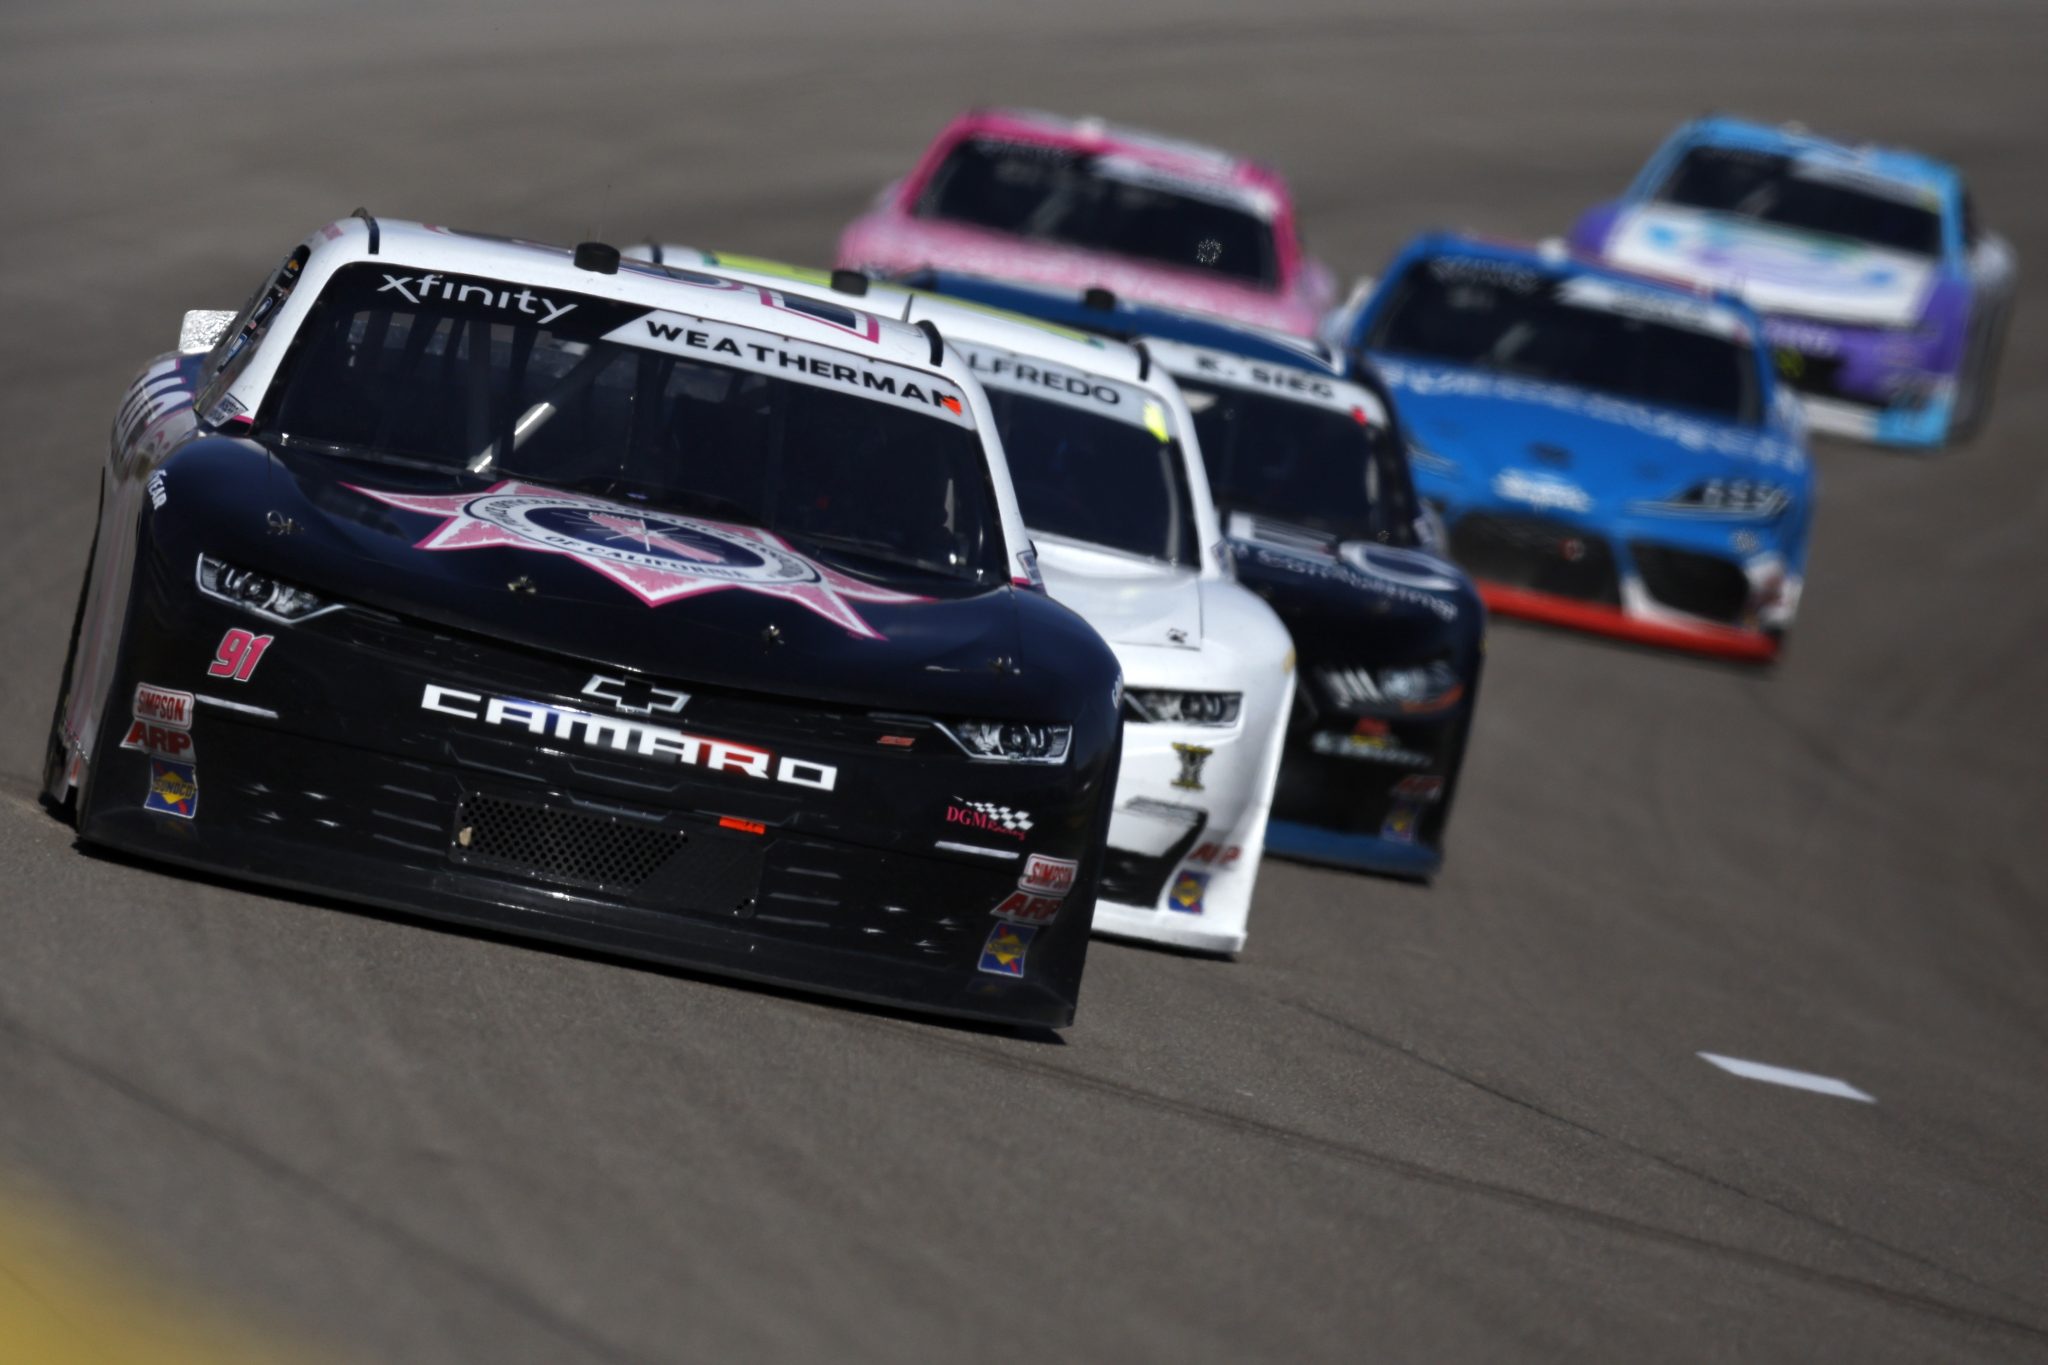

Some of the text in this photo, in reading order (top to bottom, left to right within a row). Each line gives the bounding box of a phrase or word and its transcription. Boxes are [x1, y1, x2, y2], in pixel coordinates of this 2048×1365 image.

[377, 273, 579, 325] xfinity
[968, 353, 1121, 405] LFREDO
[207, 627, 275, 682] 91
[136, 690, 187, 723] SIMPSON
[126, 720, 192, 757] ARP
[421, 683, 838, 792] CAMARO
[946, 805, 988, 829] DGM
